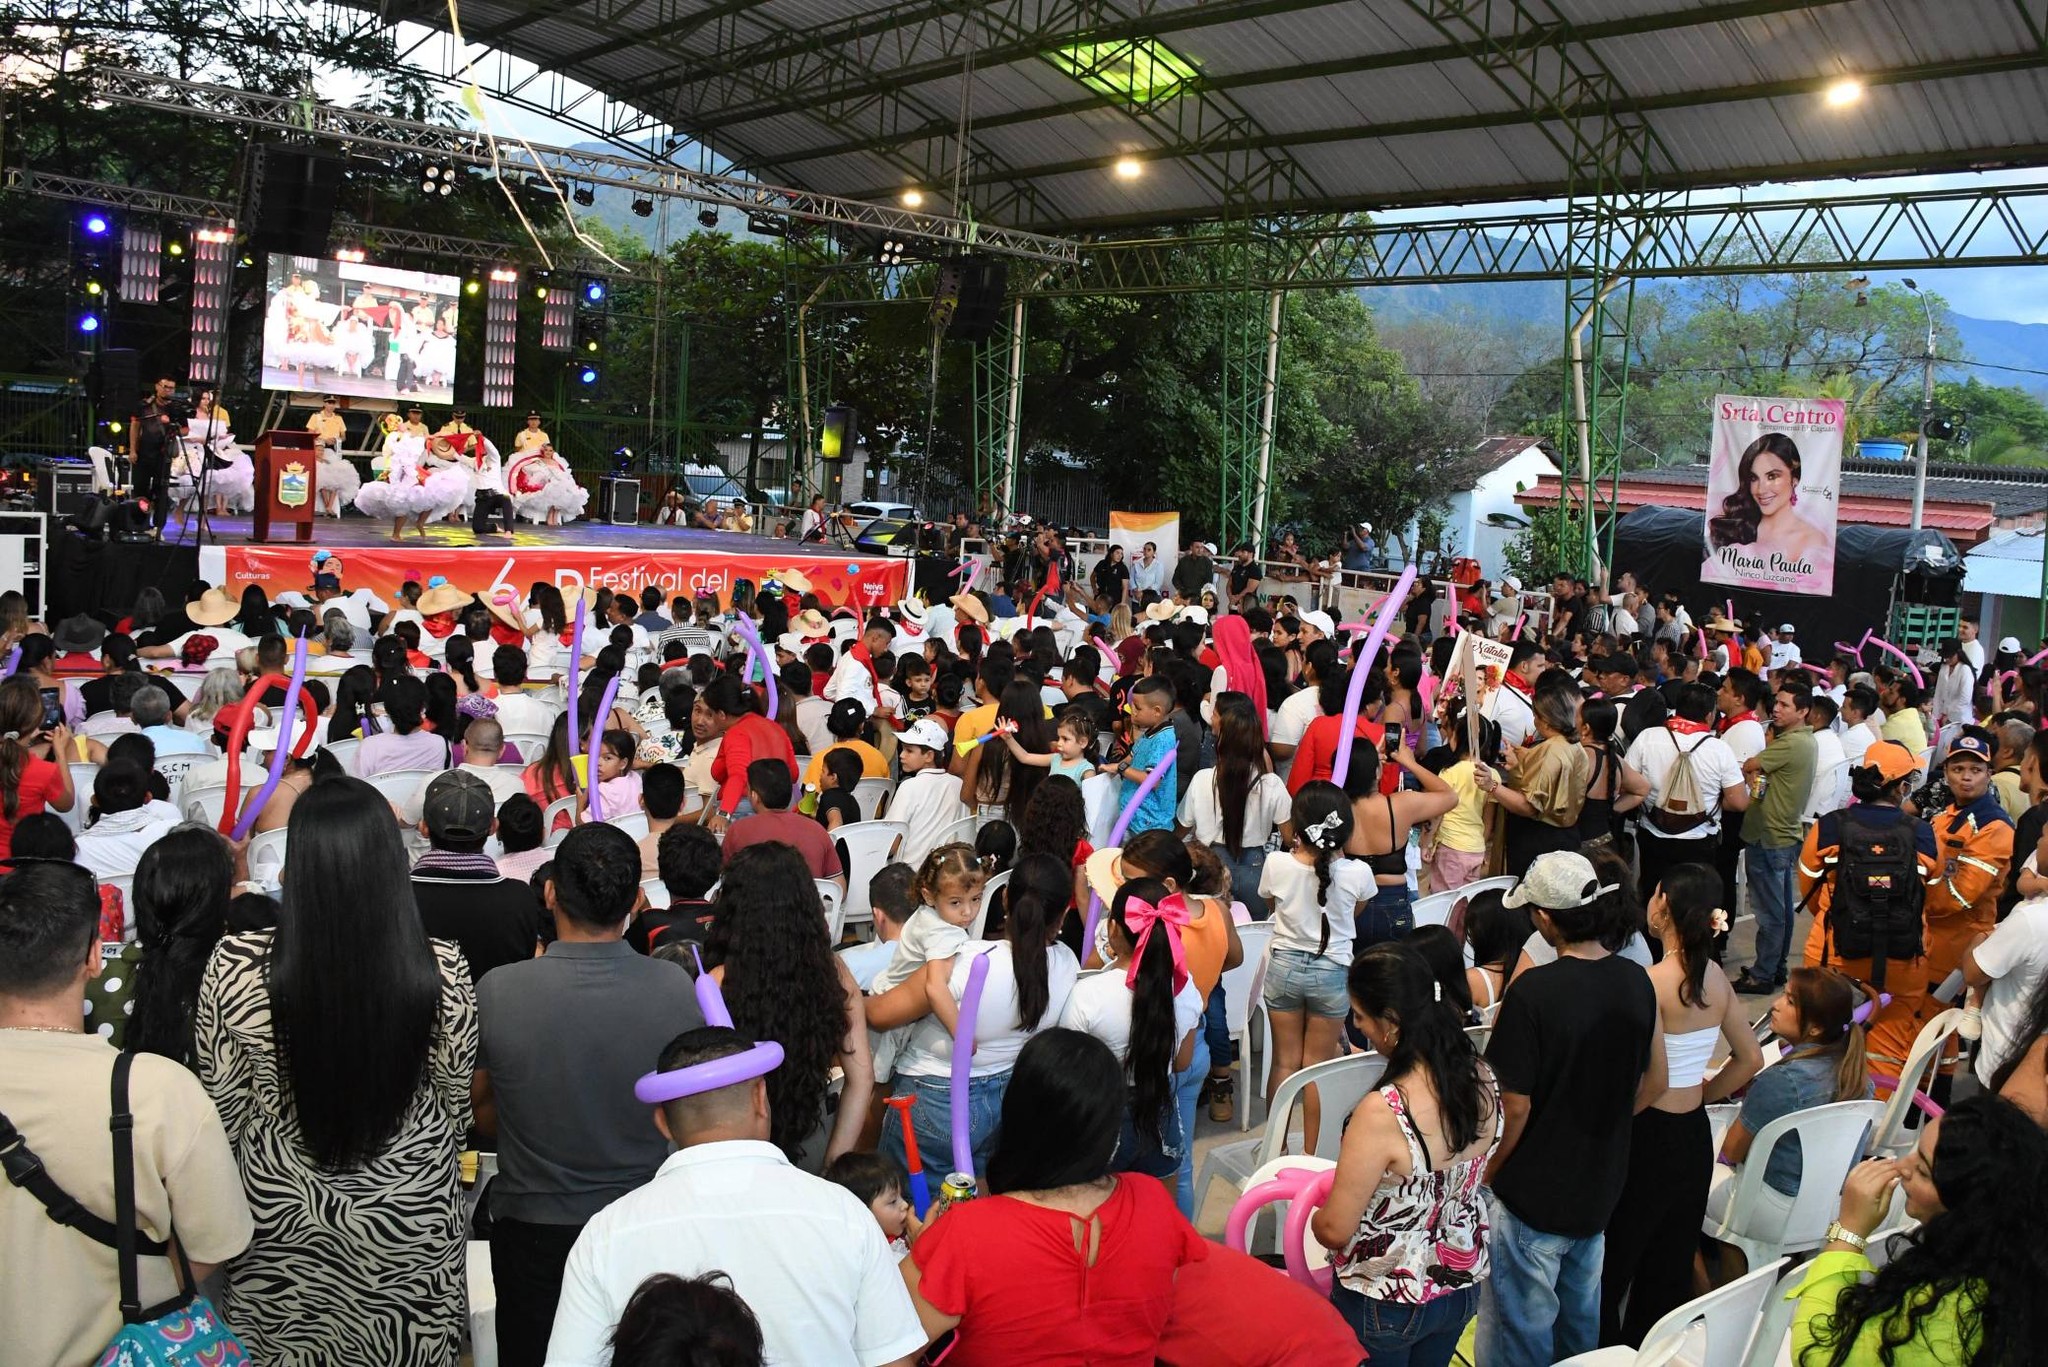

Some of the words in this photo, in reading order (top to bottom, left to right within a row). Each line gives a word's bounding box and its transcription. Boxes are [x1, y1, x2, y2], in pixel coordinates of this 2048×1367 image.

[1766, 405, 1836, 425] Centro
[1769, 552, 1814, 574] Paula
[235, 571, 270, 580] Culturas
[589, 566, 682, 591] Festival
[689, 567, 728, 593] del
[1735, 569, 1761, 579] Ninco
[1762, 571, 1796, 583] Lizcano
[863, 582, 884, 591] Neiva
[1472, 641, 1509, 660] Natalia
